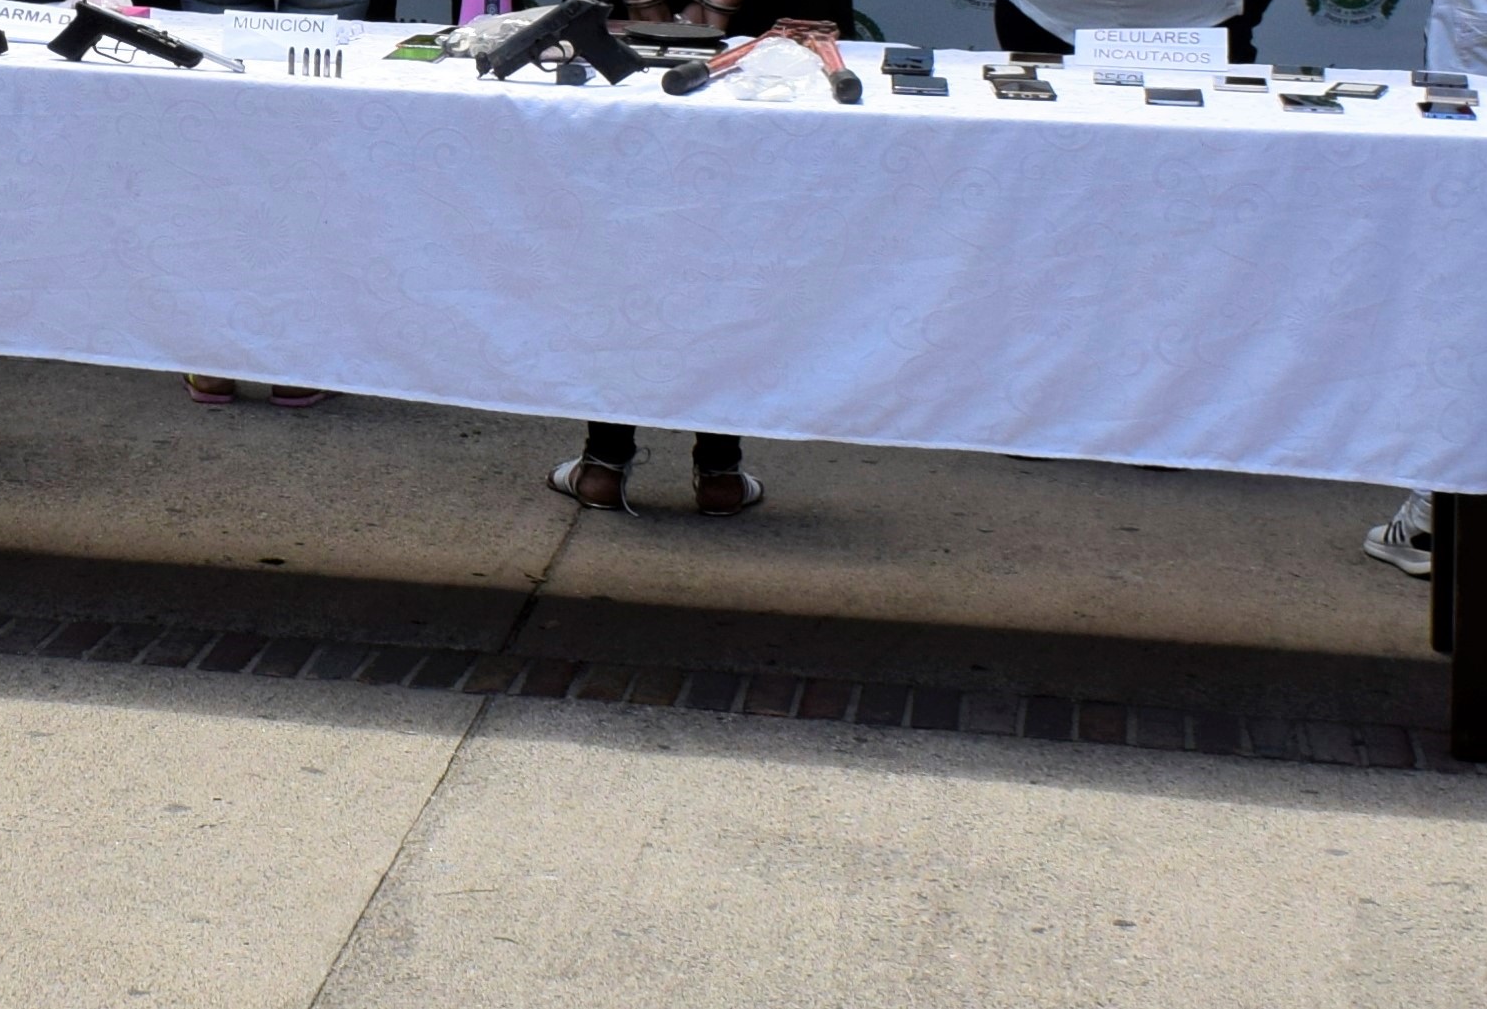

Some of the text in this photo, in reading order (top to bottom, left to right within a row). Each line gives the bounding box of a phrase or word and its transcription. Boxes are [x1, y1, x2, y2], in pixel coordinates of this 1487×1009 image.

[233, 15, 325, 34] MUNICIÓN
[1094, 30, 1201, 44] CELULARES
[1093, 48, 1212, 65] INCAUTADOS
